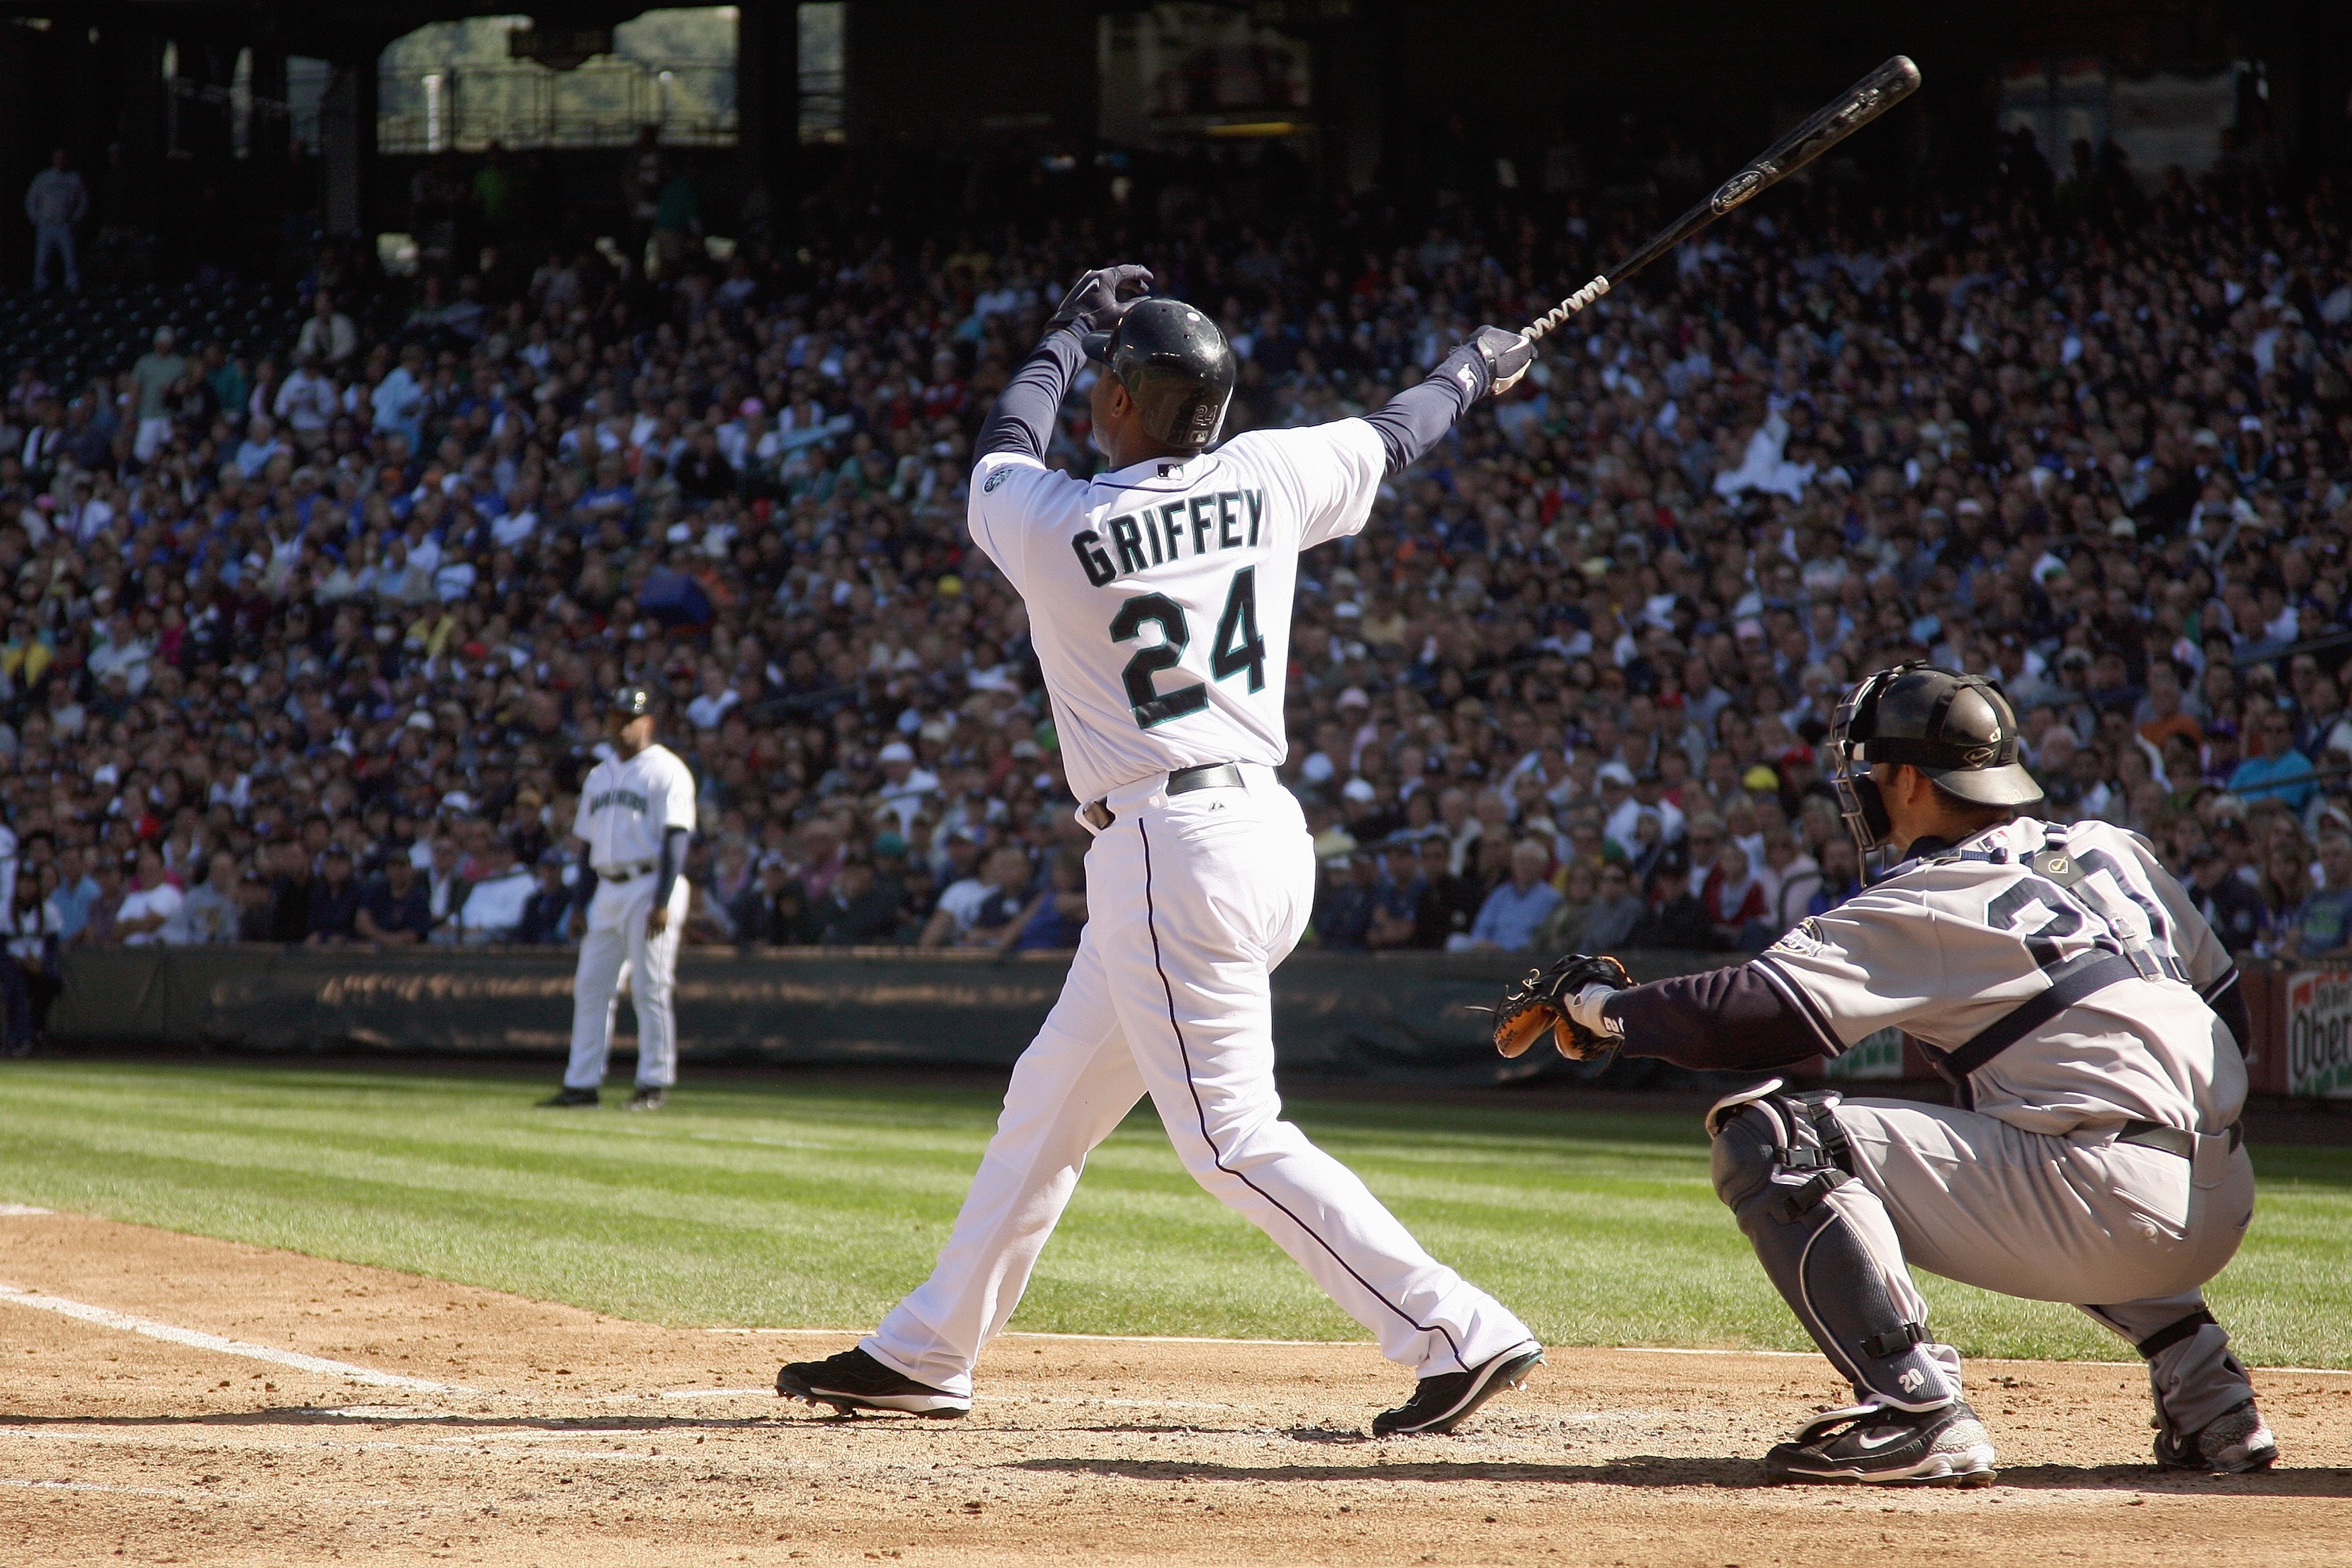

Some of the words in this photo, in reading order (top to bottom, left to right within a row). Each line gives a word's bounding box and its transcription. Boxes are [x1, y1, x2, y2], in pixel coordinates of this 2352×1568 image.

[1193, 405, 1218, 426] 24
[1072, 489, 1263, 587] GRIFFEY
[1109, 565, 1266, 730] 24
[1899, 1368, 1925, 1393] 20
